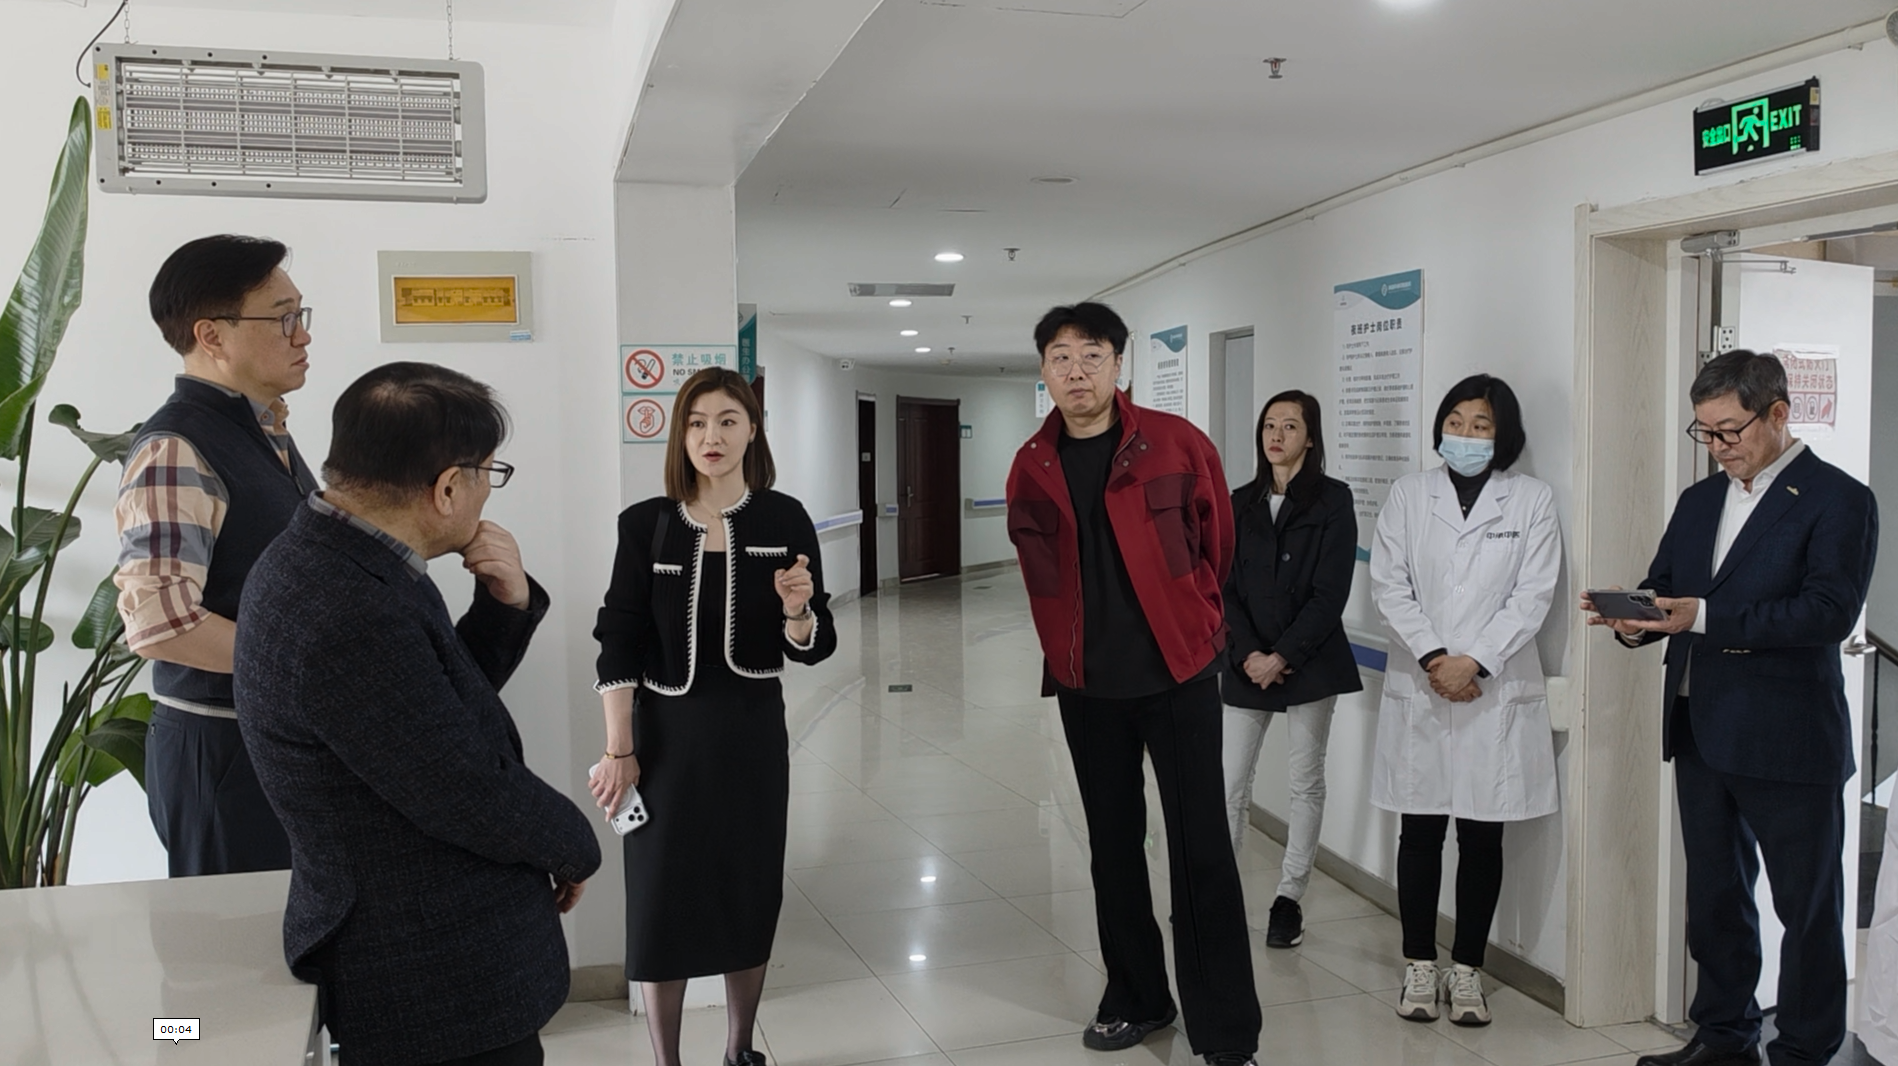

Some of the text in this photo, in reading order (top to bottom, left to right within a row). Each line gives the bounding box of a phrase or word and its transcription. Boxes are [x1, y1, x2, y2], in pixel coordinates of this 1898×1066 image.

[1769, 103, 1803, 132] EXIT
[1702, 123, 1731, 149] 安全出口
[671, 353, 727, 366] 禁止吸烟
[672, 368, 686, 376] NO
